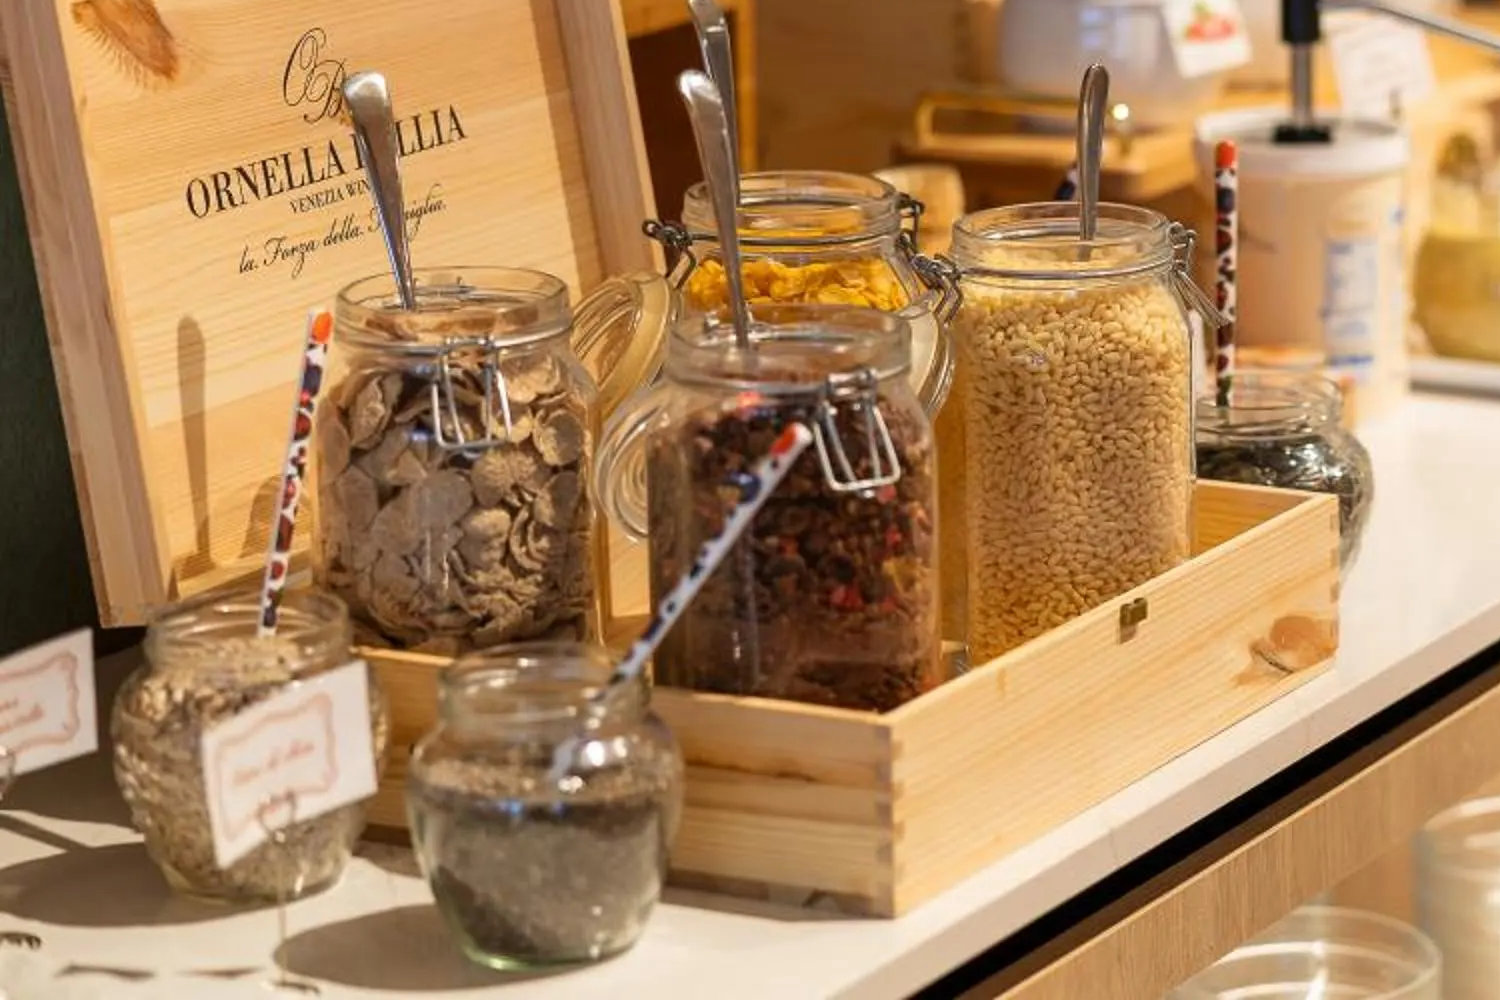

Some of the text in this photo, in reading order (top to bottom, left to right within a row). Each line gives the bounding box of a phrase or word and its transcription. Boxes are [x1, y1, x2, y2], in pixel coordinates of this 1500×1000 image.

[186, 103, 468, 219] ORNELLA LLIA
[289, 178, 372, 214] VENEZIA WIN
[263, 236, 320, 280] Forza
